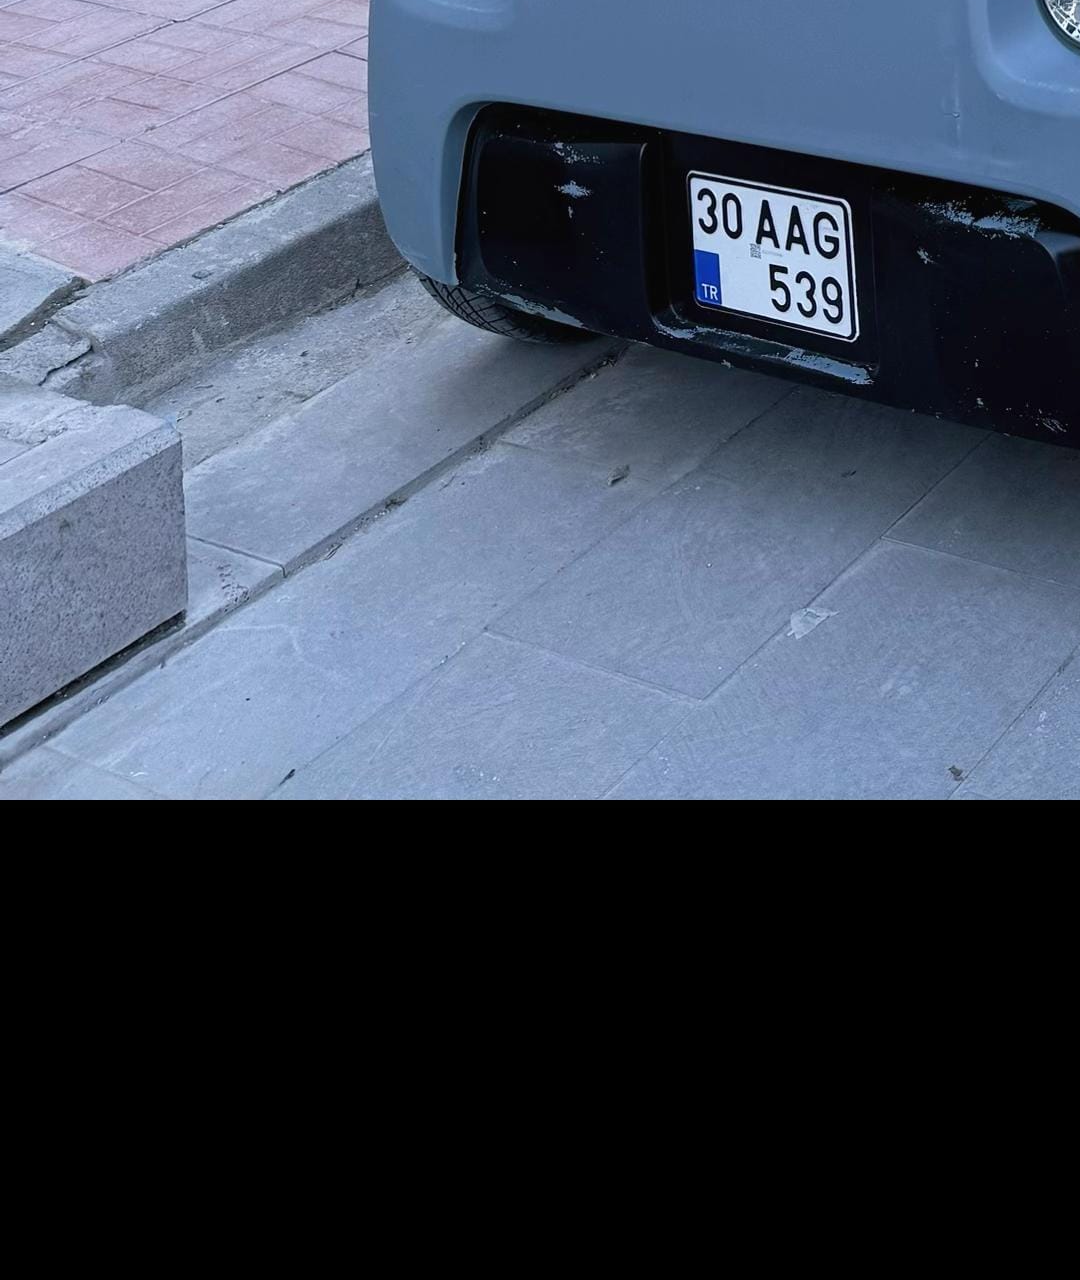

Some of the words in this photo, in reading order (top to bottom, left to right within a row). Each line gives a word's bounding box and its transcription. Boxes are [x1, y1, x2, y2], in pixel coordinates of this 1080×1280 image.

[698, 188, 743, 240] 30
[755, 199, 840, 260] AAG
[701, 283, 719, 301] TR
[769, 263, 844, 325] 539
